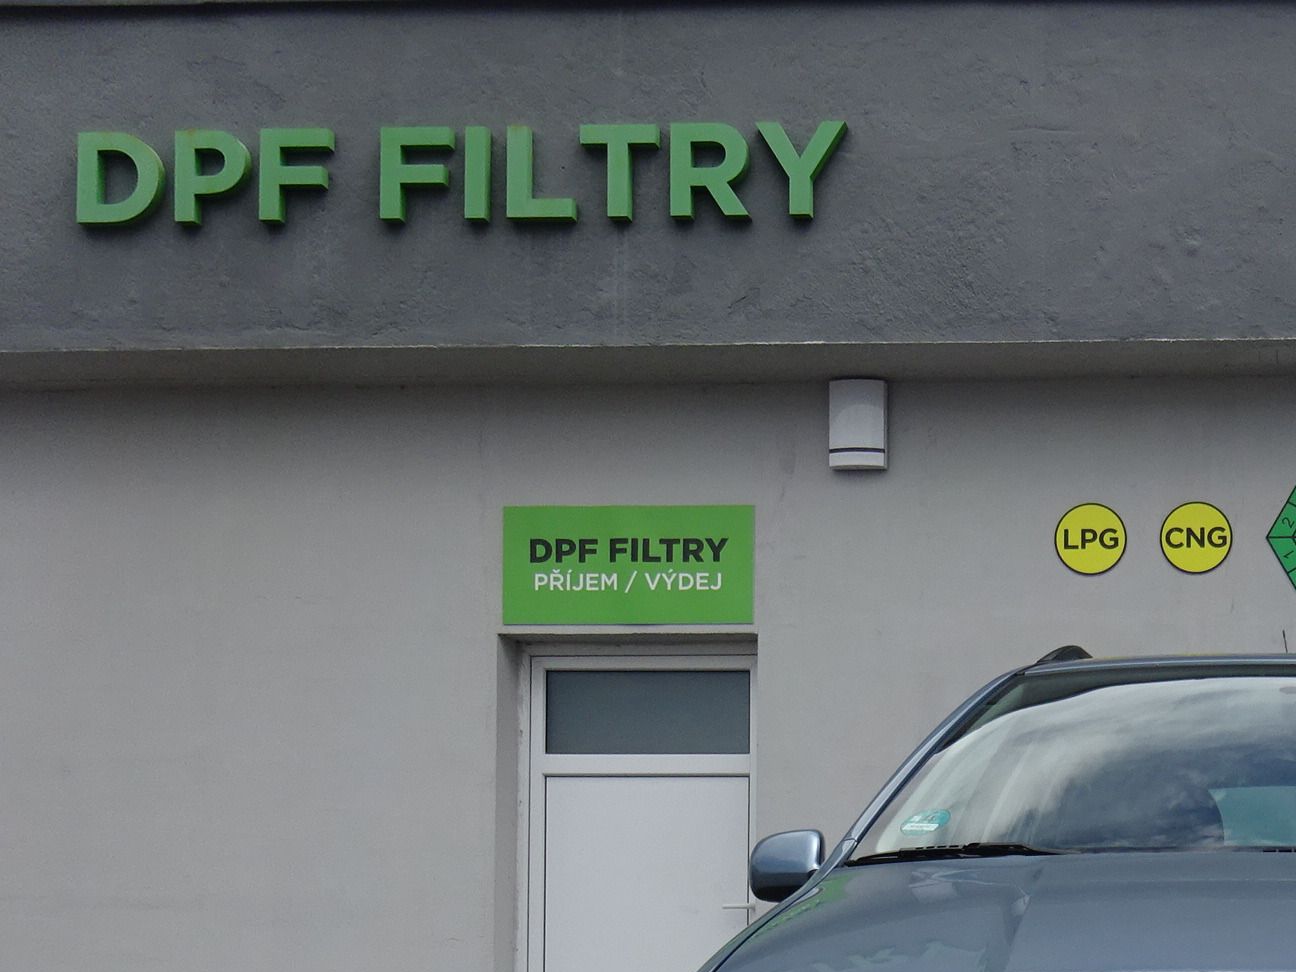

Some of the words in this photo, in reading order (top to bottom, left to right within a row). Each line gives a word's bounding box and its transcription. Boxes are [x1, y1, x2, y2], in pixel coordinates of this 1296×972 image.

[75, 126, 335, 226] DPF
[379, 120, 849, 223] FILTRY
[1281, 516, 1296, 529] 2
[1063, 528, 1119, 550] LPG
[1165, 526, 1228, 549] CNG
[529, 538, 599, 564] DPF
[609, 537, 729, 563] FILTRY
[534, 568, 618, 591] PŘÍJEM
[624, 570, 638, 593] /
[644, 569, 722, 591] VÝDEJ
